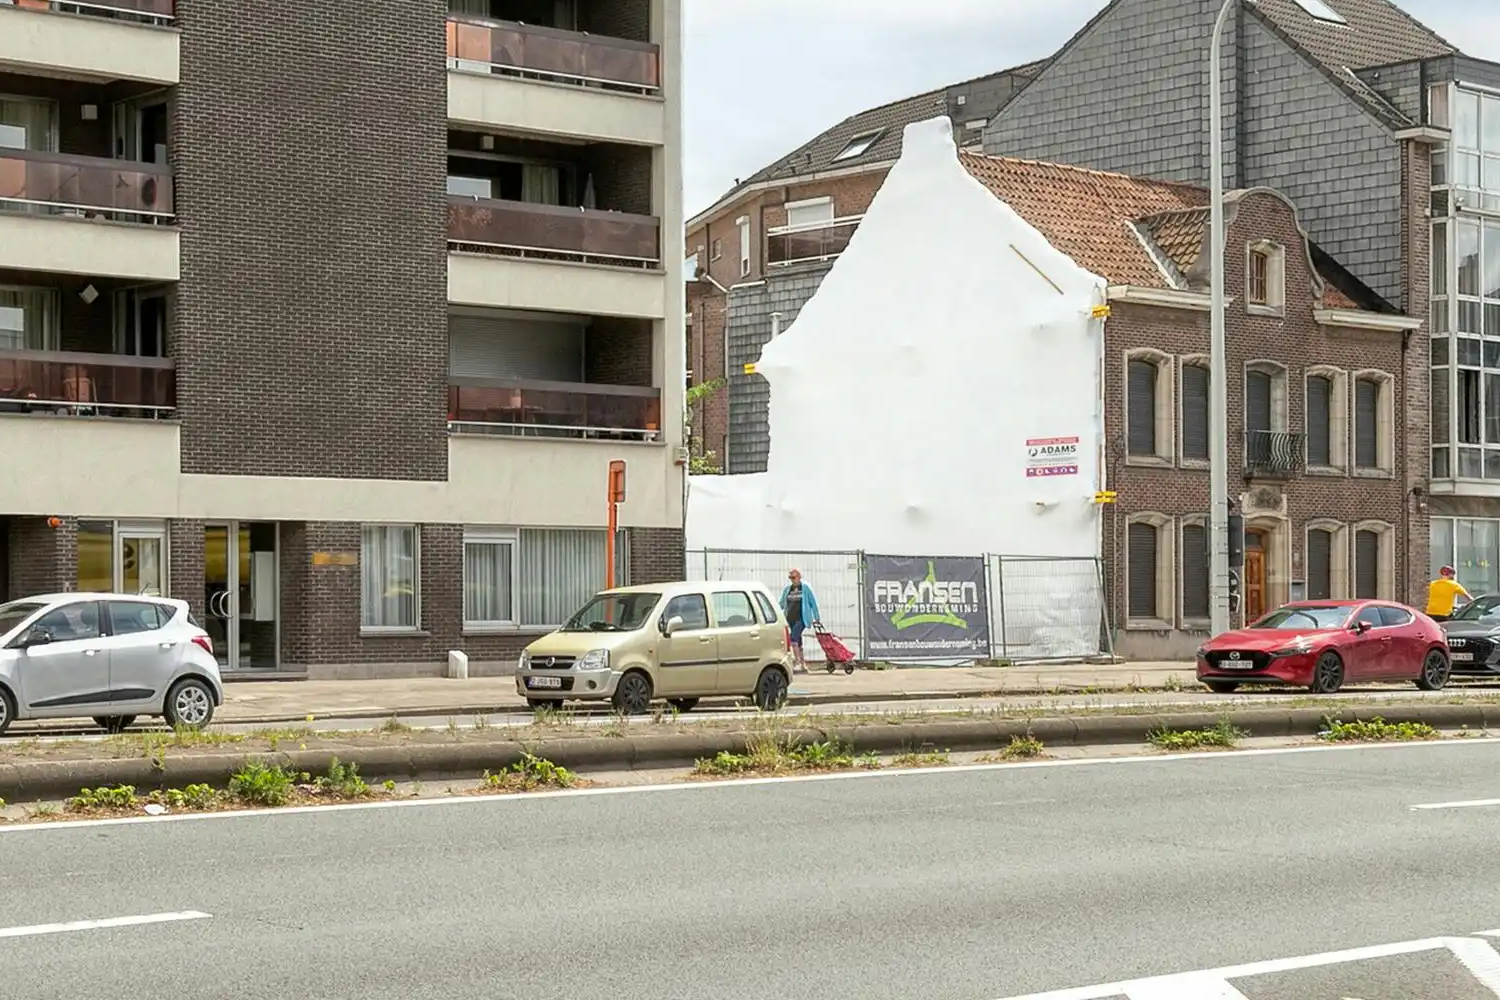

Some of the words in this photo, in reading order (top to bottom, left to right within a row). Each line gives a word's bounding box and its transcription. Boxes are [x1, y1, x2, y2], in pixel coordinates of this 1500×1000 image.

[1041, 445, 1077, 454] ADAMS
[874, 580, 978, 604] FRANSEN
[875, 604, 978, 613] BOUWONDERNEMING
